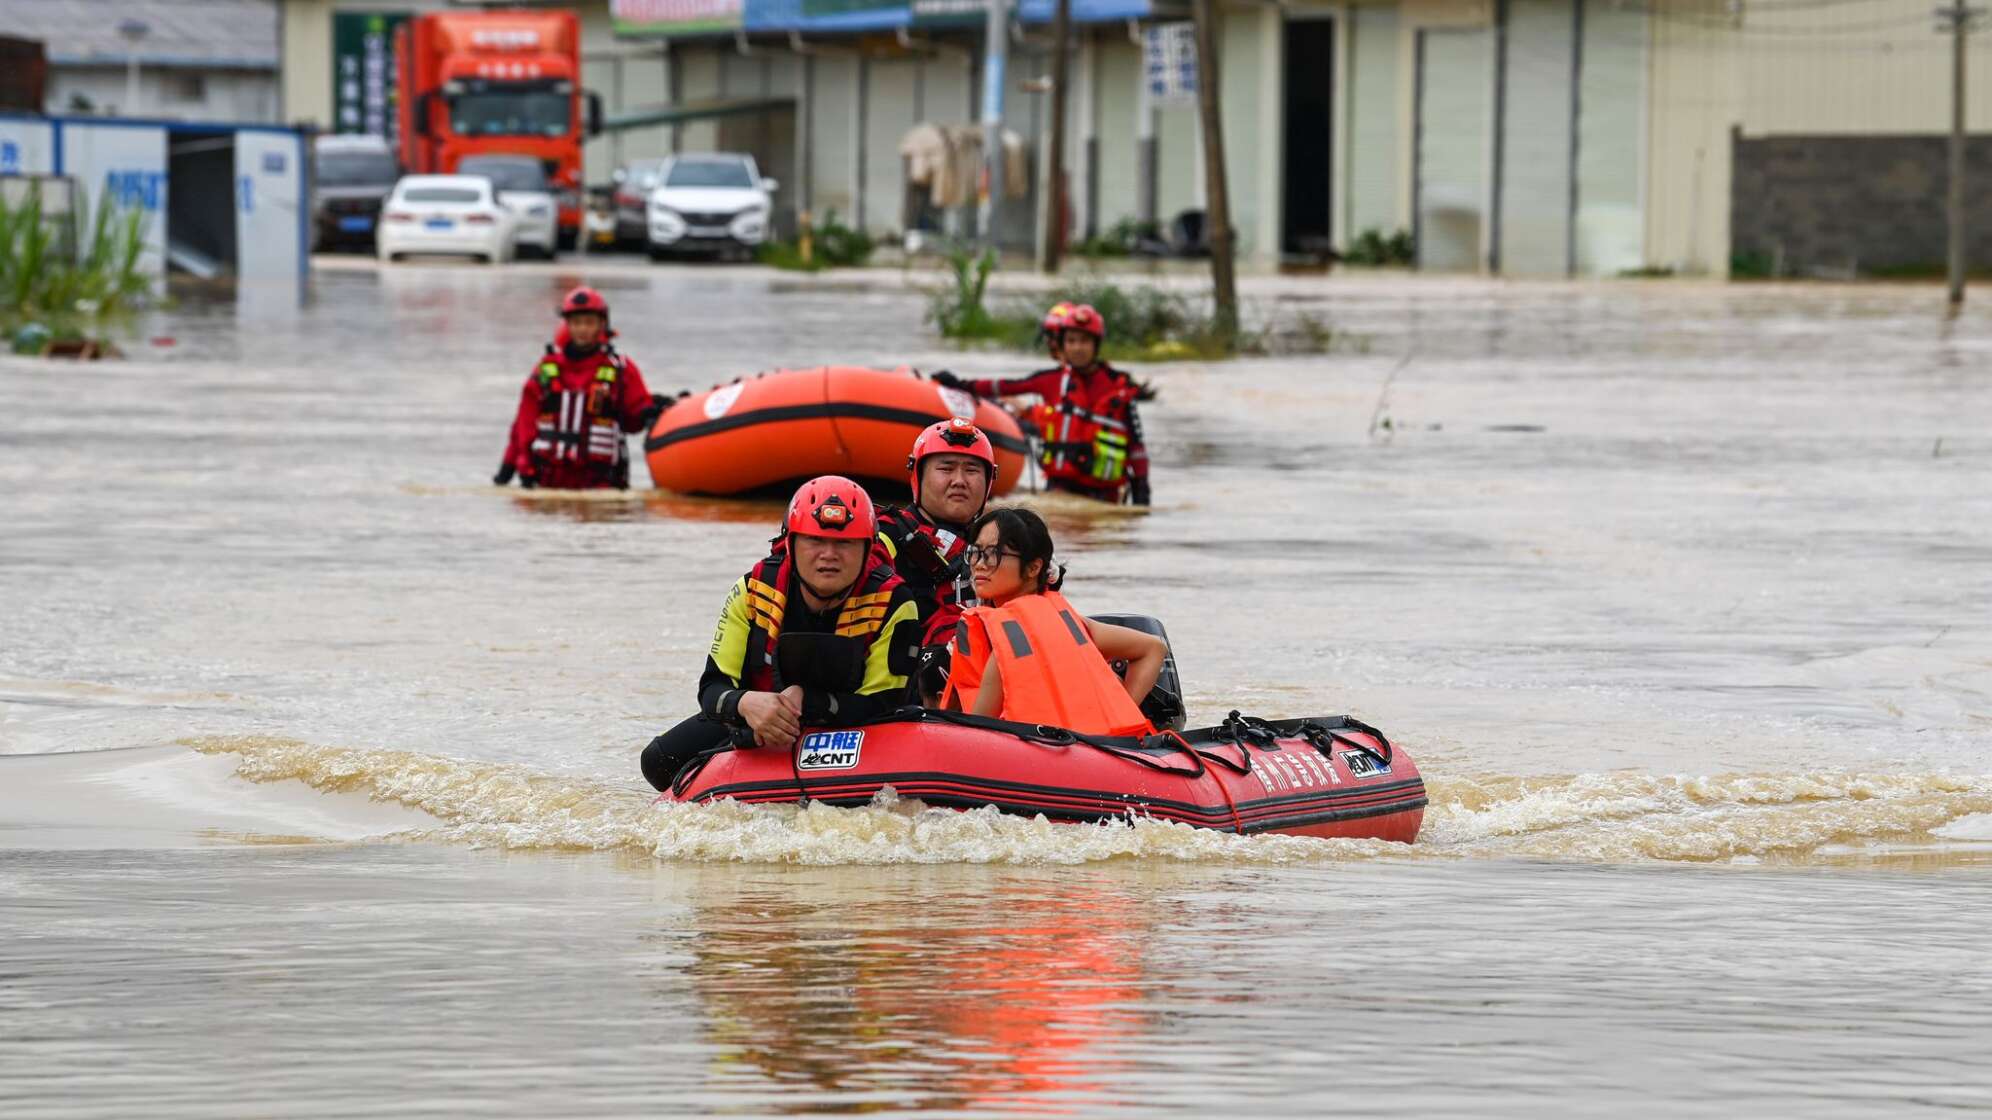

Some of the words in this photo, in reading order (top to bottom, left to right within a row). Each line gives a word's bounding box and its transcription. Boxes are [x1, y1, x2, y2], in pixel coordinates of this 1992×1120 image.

[711, 584, 741, 654] RESCUE
[804, 732, 859, 752] 中艇
[820, 753, 855, 765] CNT
